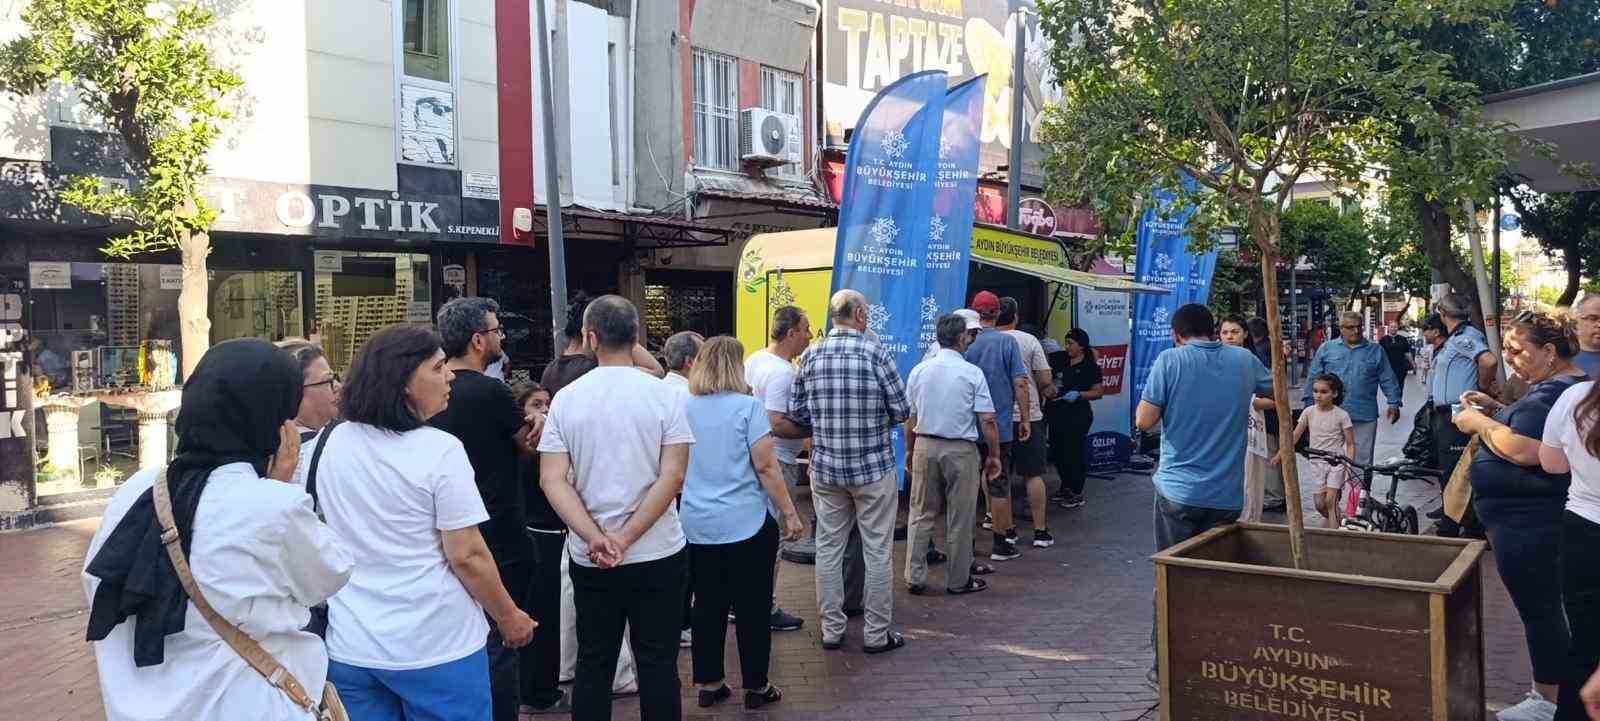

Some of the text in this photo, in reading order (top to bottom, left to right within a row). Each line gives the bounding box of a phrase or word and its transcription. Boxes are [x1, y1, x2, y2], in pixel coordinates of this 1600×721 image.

[838, 7, 964, 89] TAPTAZE
[889, 161, 913, 169] AYDIN
[856, 165, 927, 182] BÜYÜKŞEHİR
[938, 167, 969, 180] ŞEHİR
[867, 179, 913, 190] BELEDİYESİ
[275, 190, 440, 232] OPTİK
[447, 224, 499, 236] S.KEPENEKLİ
[880, 247, 903, 256] AYDIN
[976, 240, 995, 251] AYDIN
[847, 252, 917, 268] BÜYÜKŞEHİR
[927, 250, 961, 262] KŞEHİR
[857, 265, 904, 276] BELEDİYESİ
[926, 261, 951, 270] DİYESİ
[1268, 623, 1311, 644] T.C.
[1253, 646, 1330, 671] AYDIN
[1201, 659, 1393, 709] BÜYÜKŞEHİR
[1224, 689, 1366, 721] BELEDİYESİ
